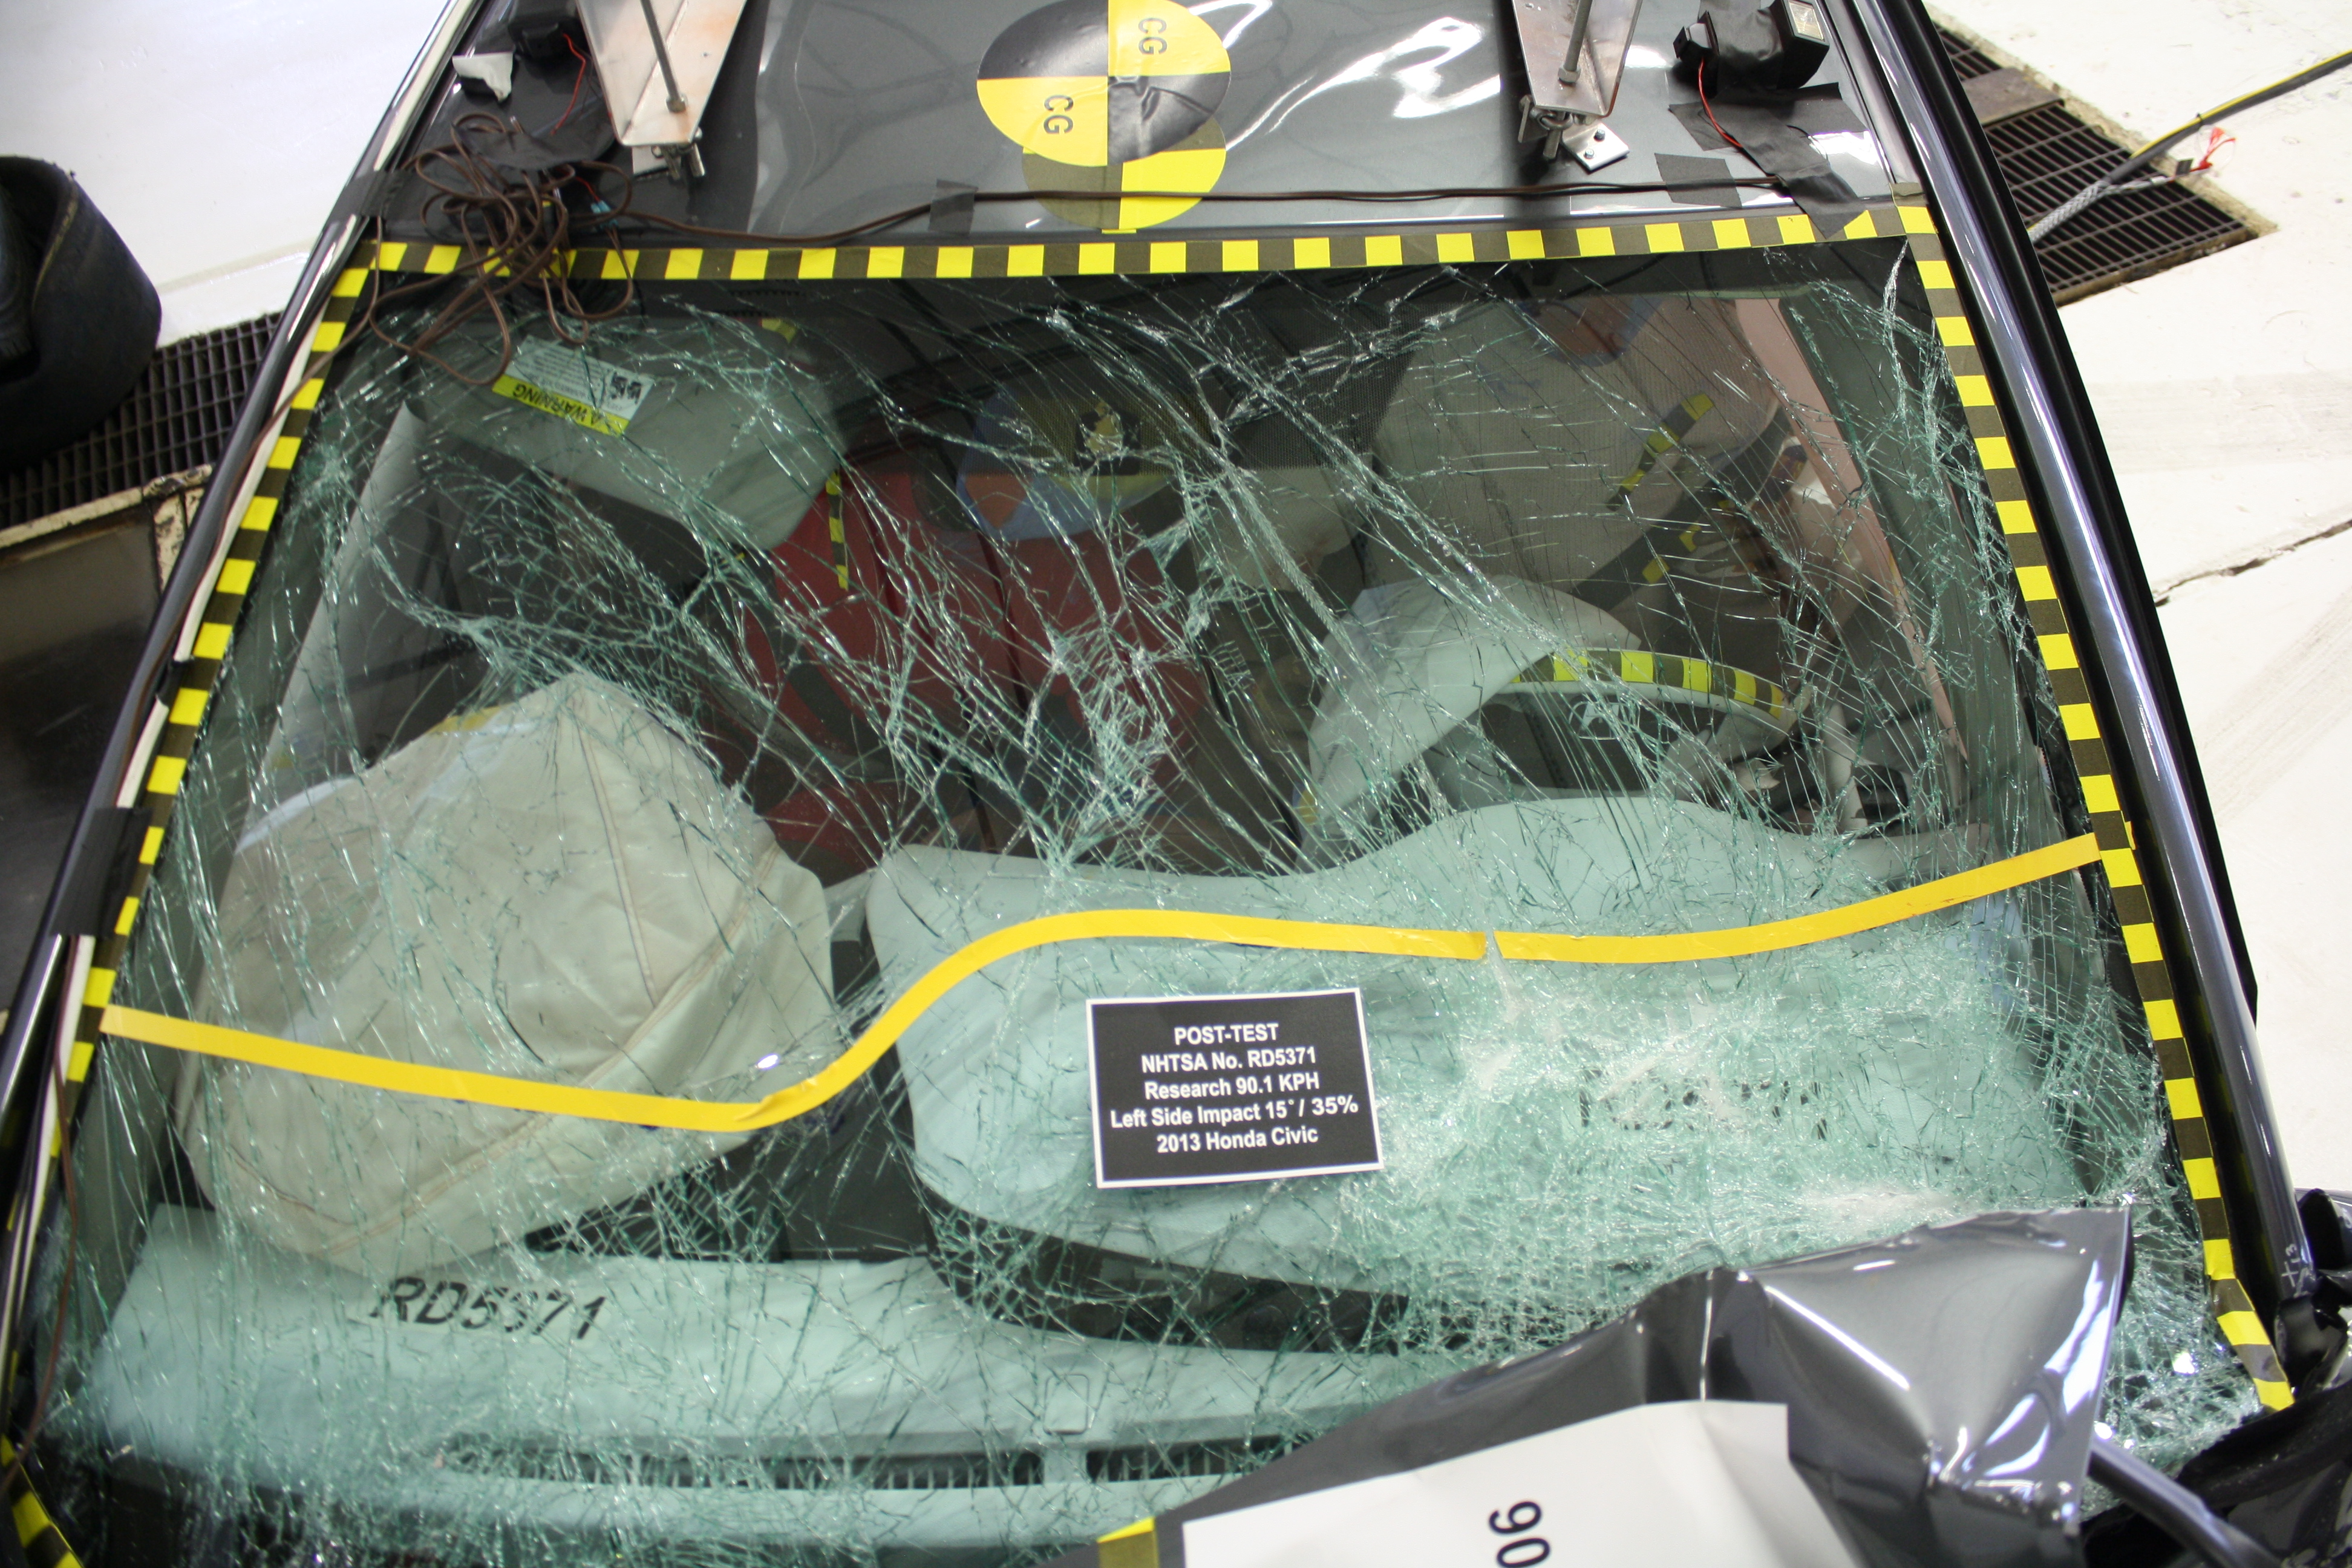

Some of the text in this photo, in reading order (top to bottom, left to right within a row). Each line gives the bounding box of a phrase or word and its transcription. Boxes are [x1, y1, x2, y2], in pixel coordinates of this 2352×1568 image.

[1138, 18, 1167, 54] CG
[1044, 95, 1073, 134] CG
[512, 384, 588, 423] WARNING
[1174, 1022, 1279, 1046] POST-TEST
[1141, 1045, 1316, 1074] NHTSA No. RD5371
[1144, 1071, 1320, 1100] Research 90.1 KPH
[1109, 1107, 1149, 1129] Left
[1151, 1106, 1194, 1127] Side
[1197, 1102, 1262, 1127] Impact
[1311, 1094, 1359, 1116] 35%
[1156, 1125, 1319, 1154] 2013 Honda Civic
